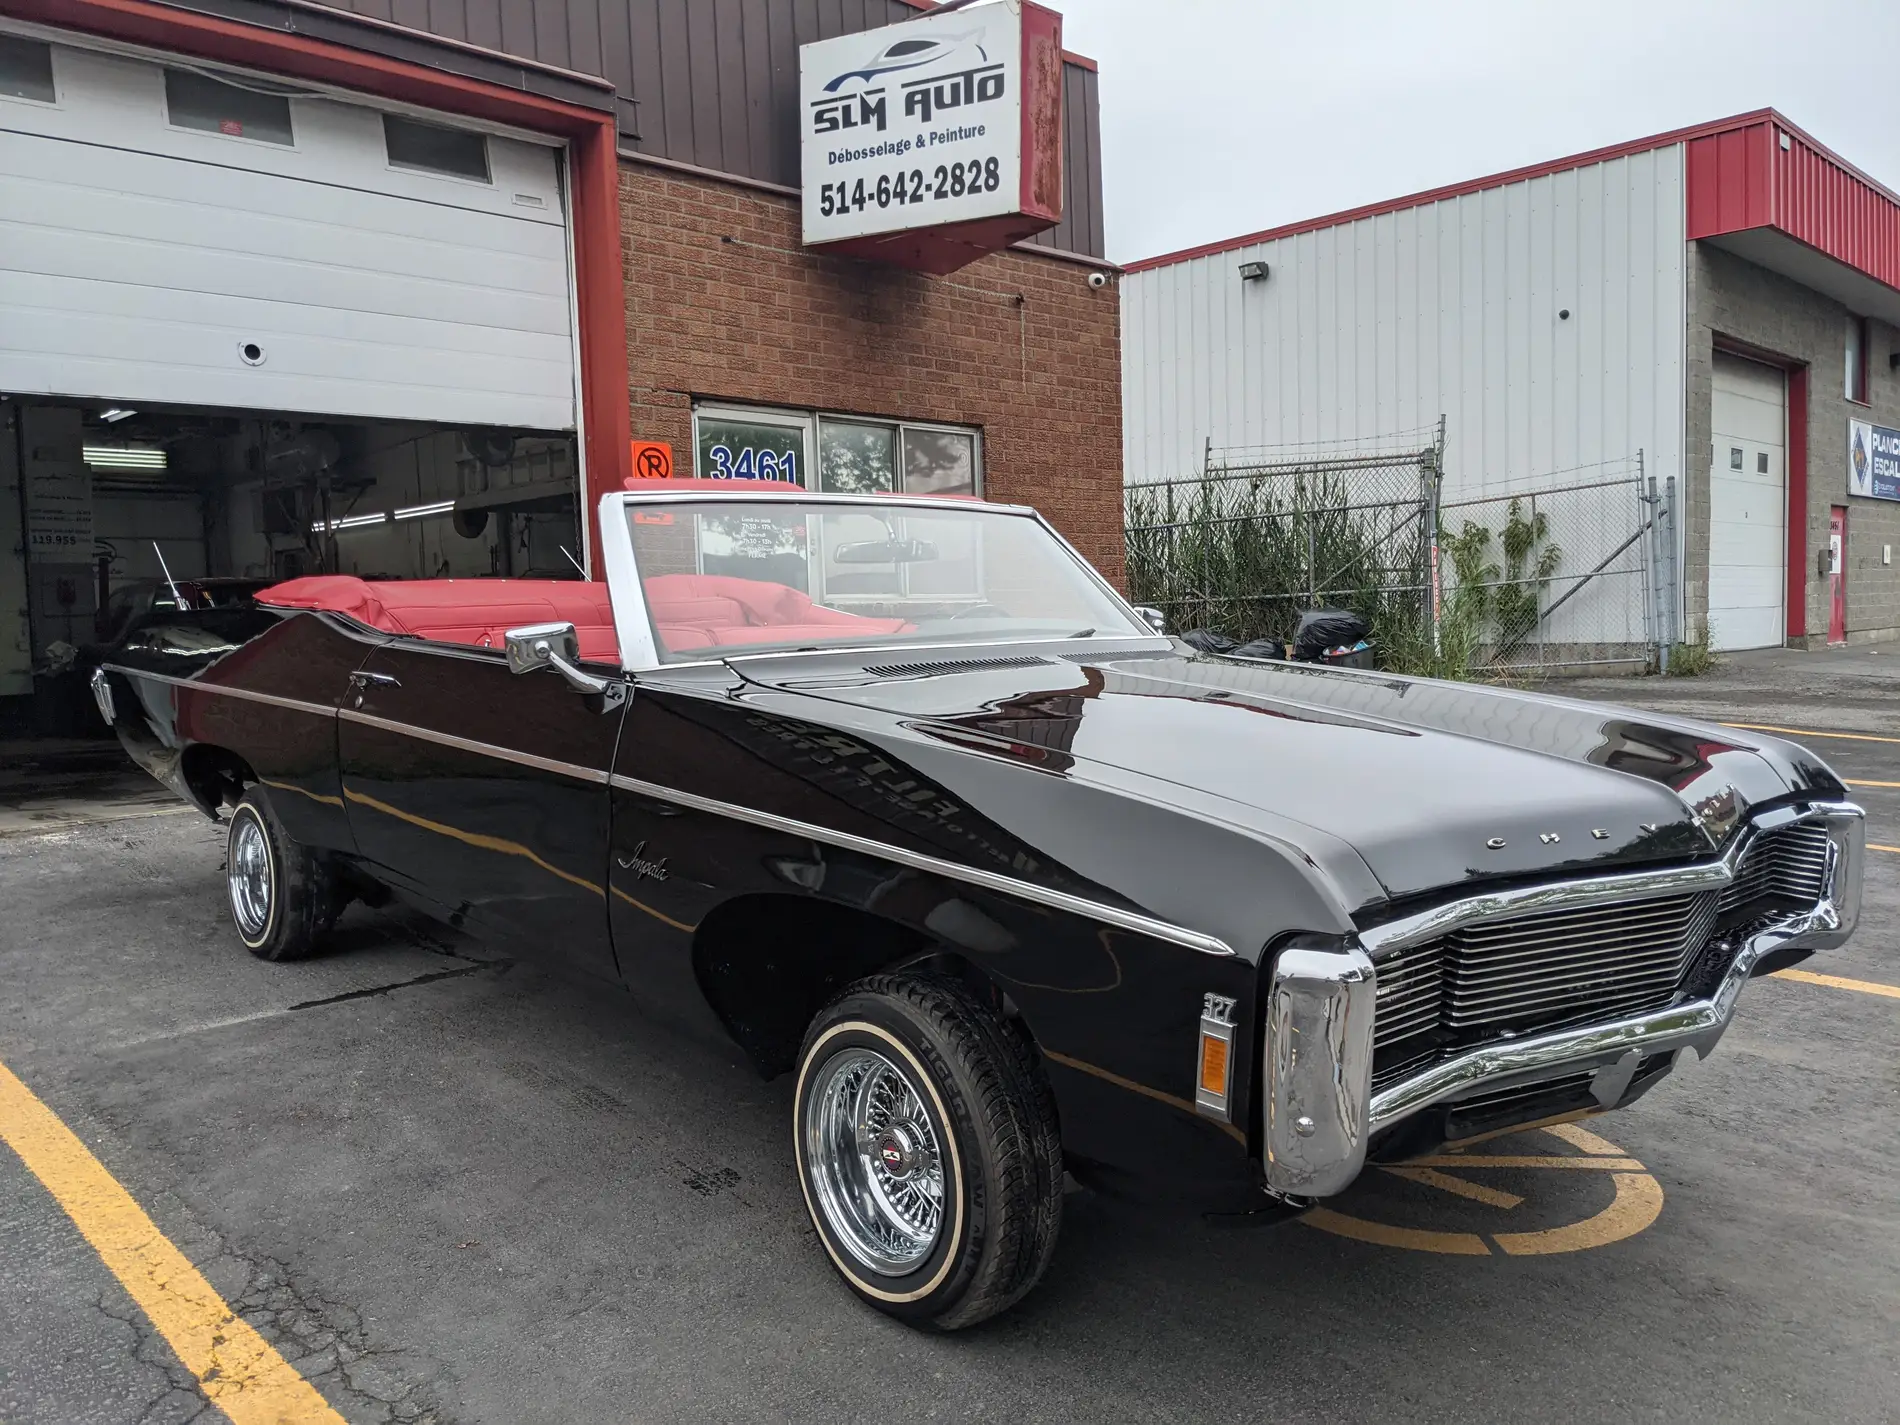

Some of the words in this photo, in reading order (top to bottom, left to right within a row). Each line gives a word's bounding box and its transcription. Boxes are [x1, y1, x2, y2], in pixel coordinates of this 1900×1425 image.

[810, 87, 887, 134] SLM
[901, 63, 1005, 123] AUTO
[828, 139, 911, 165] Débosselage
[916, 134, 926, 149] &
[929, 125, 986, 146] Peinture
[820, 156, 1000, 217] 514-642-2828
[709, 445, 797, 484] 3461
[617, 840, 669, 881] Impala
[1201, 992, 1238, 1023] 327
